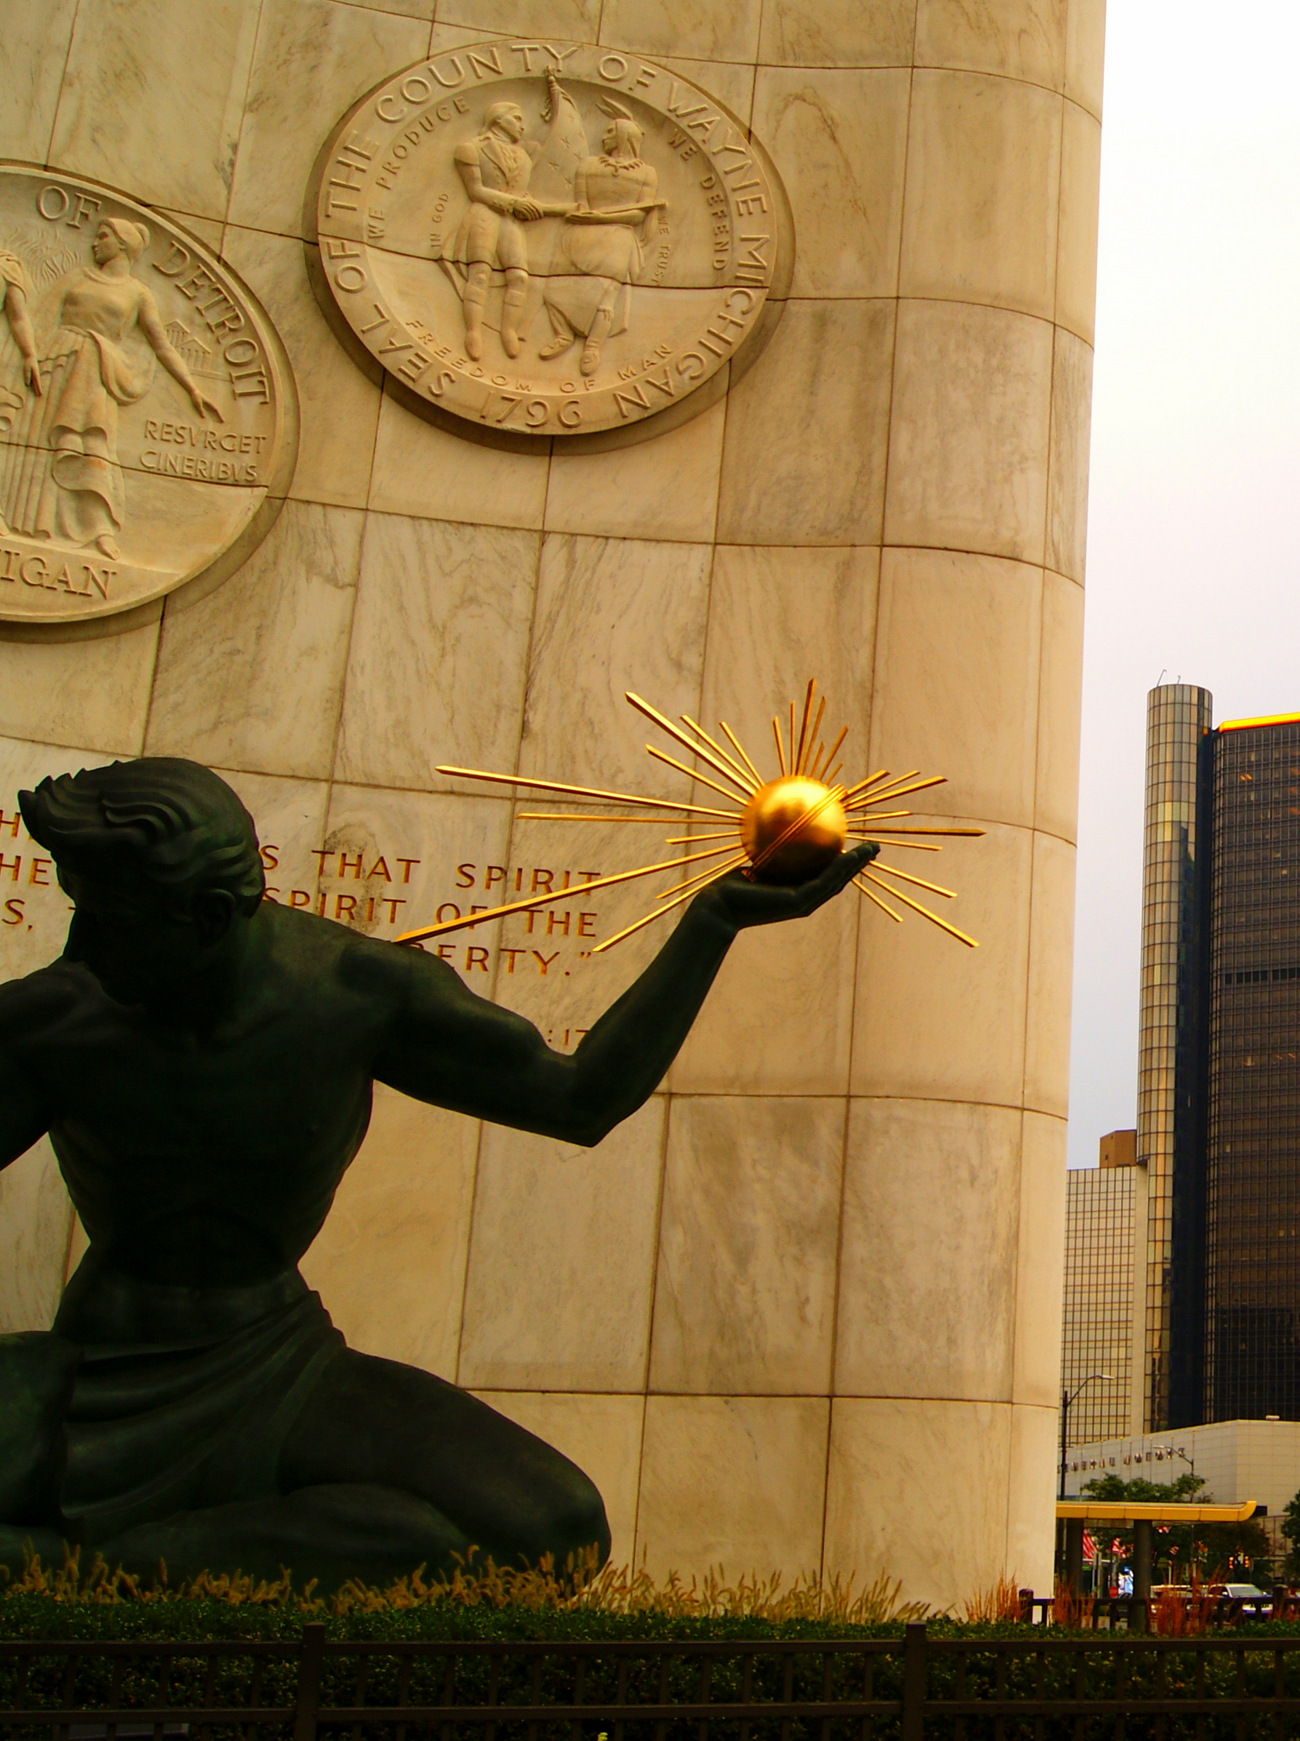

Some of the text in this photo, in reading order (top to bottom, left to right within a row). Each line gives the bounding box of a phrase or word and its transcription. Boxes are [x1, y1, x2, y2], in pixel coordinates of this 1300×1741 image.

[368, 96, 471, 240] WE PRODUCE
[668, 128, 730, 271] WE DEFEND
[325, 44, 770, 428] SEAL OF THE COUNTY OF WAYNE MICHIGAN 1796
[430, 192, 450, 249] IN GOD
[36, 184, 271, 407] OF DETROIT
[651, 244, 671, 286] TRUST
[405, 319, 673, 394] FREEDOM OF MAN
[311, 850, 421, 883] THAT
[455, 863, 601, 897] SPIRIT
[520, 908, 598, 937] THE
